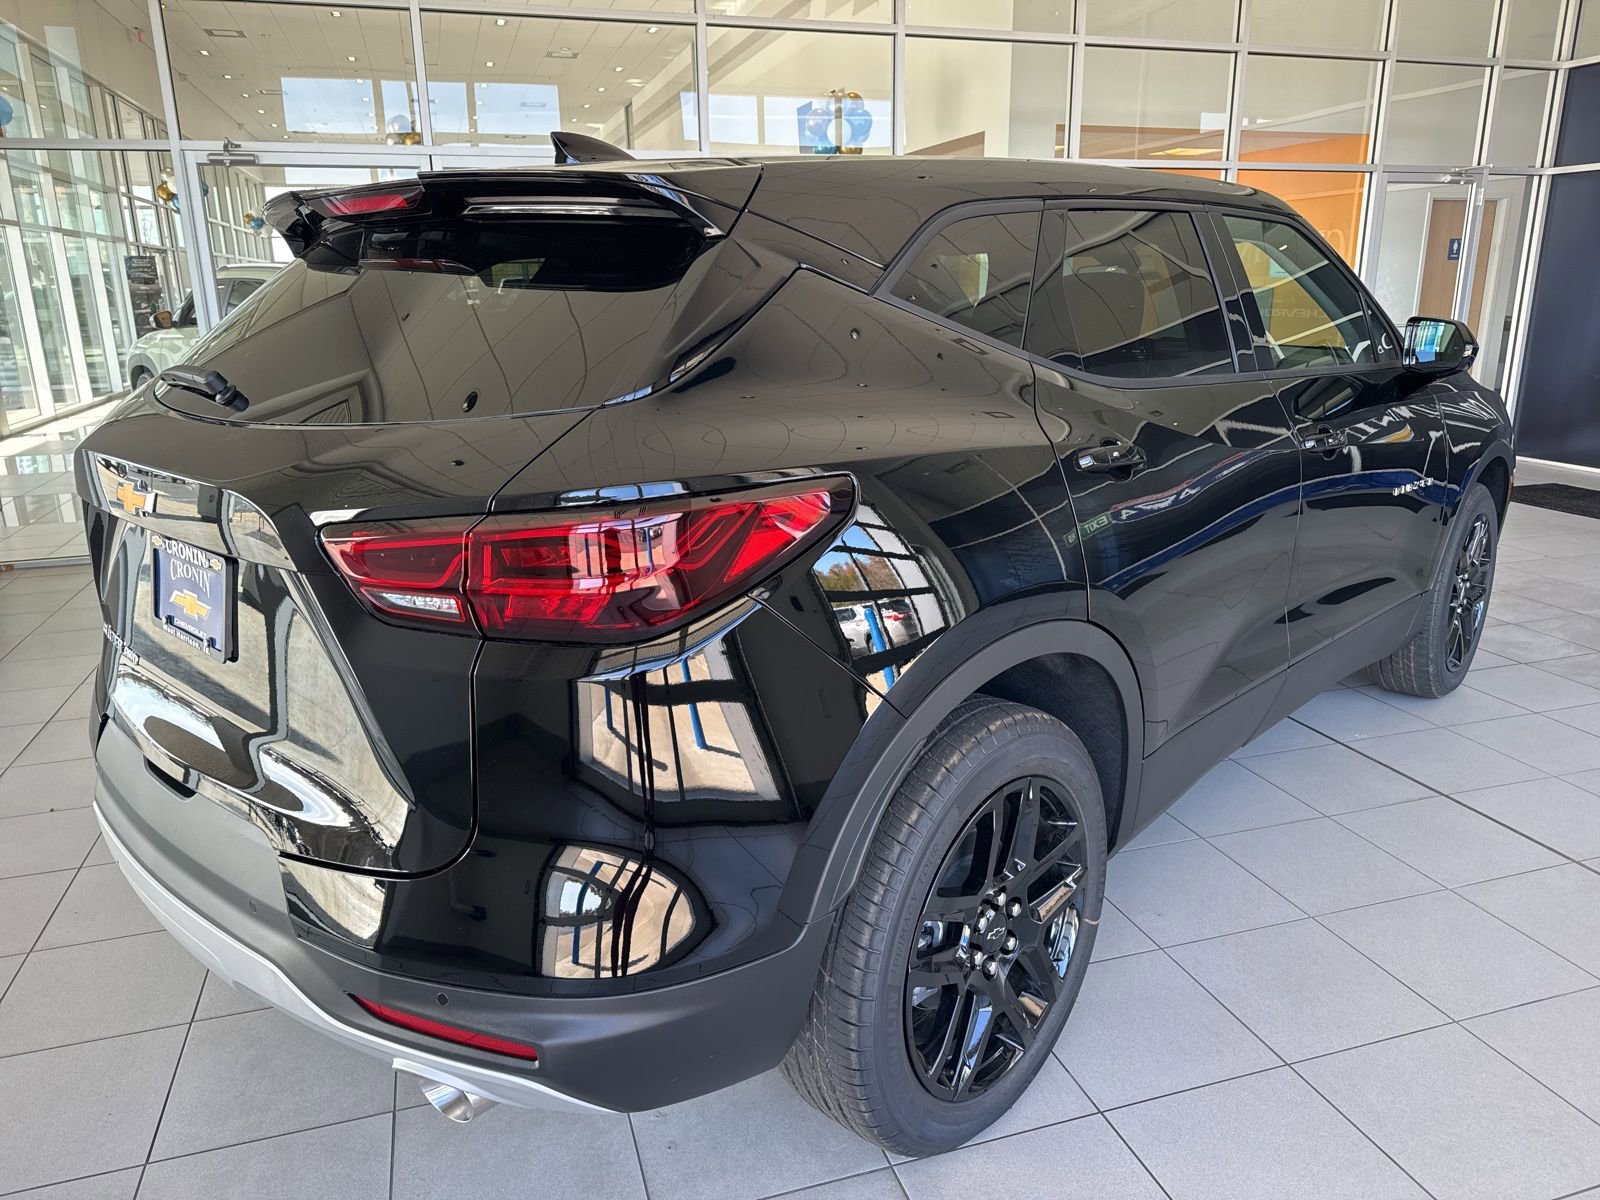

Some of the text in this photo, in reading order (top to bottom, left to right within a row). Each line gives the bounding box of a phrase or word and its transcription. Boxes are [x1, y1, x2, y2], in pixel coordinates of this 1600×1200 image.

[165, 539, 208, 568] CRONIN
[170, 558, 211, 599] CRONIN
[892, 842, 940, 968] PRIMACY TOUR
